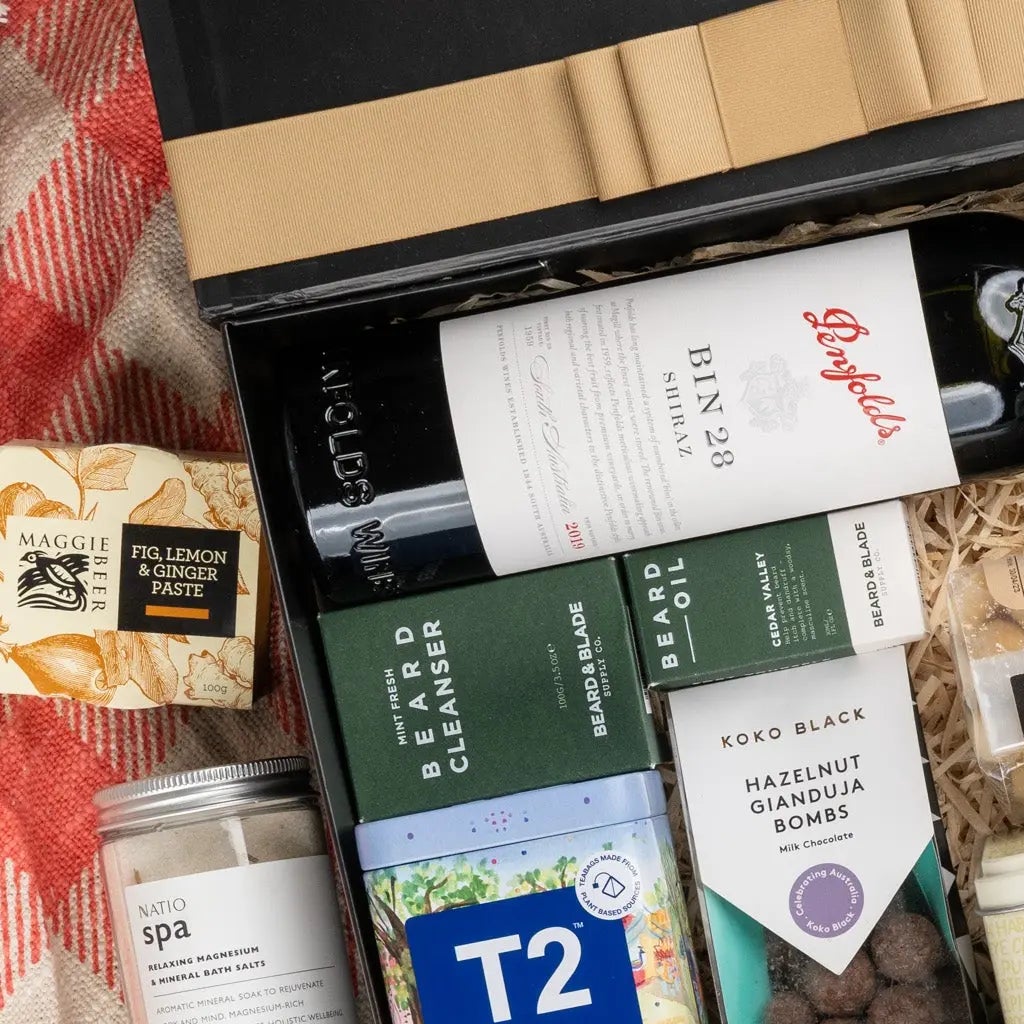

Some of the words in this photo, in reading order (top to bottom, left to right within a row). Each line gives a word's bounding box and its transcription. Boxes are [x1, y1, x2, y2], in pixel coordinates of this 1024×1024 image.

[688, 344, 723, 416] BIN
[662, 371, 692, 458] SHIRAZ
[705, 427, 734, 468] 28
[19, 532, 109, 549] MAGGIE
[564, 521, 586, 550] 2019
[854, 522, 871, 567] BLADE
[131, 545, 163, 562] FIG,
[166, 548, 228, 565] LEMON
[138, 564, 151, 577] &
[153, 565, 218, 582] GINGER
[864, 568, 875, 578] &
[91, 555, 108, 613] BEER
[151, 582, 204, 598] PASTE
[668, 558, 691, 609] OIL
[755, 552, 773, 600] VALLEY
[644, 563, 678, 669] BEARD
[867, 580, 884, 627] BEARD
[569, 601, 593, 660] BLADE
[766, 604, 782, 647] CEDAR
[581, 662, 595, 675] &
[202, 683, 228, 694] 100g
[384, 668, 400, 710] FRESH
[396, 626, 441, 779] BEARD
[423, 620, 468, 773] CLEANSER
[584, 677, 608, 737] BEARD
[392, 714, 407, 745] MINT
[721, 727, 782, 748] KOKO
[795, 708, 866, 735] BLACK
[746, 754, 862, 792] HAZELNUT
[750, 778, 865, 814] GIANDUJA
[774, 804, 849, 833] BOMBS
[779, 843, 800, 854] Milk
[803, 831, 854, 848] Chocolate
[580, 858, 599, 886] TEABAGS
[829, 869, 859, 904] Australia
[138, 897, 186, 919] NATIO
[581, 892, 598, 911] PLANT
[794, 870, 826, 916] Celebrating
[142, 917, 191, 950] spa
[807, 920, 830, 932] Koko
[832, 912, 855, 931] Black
[148, 957, 193, 972] RELAXING
[196, 946, 259, 963] MAGNESIUM
[159, 970, 200, 985] MINERAL
[204, 965, 232, 977] BATH
[235, 960, 266, 971] SALTS
[455, 926, 592, 1023] T2
[156, 1001, 194, 1015] AROMATIC
[197, 995, 235, 1008] MINERAL
[238, 990, 262, 1000] SOAK
[264, 987, 276, 996] TO
[279, 979, 324, 994] REJUVENATE
